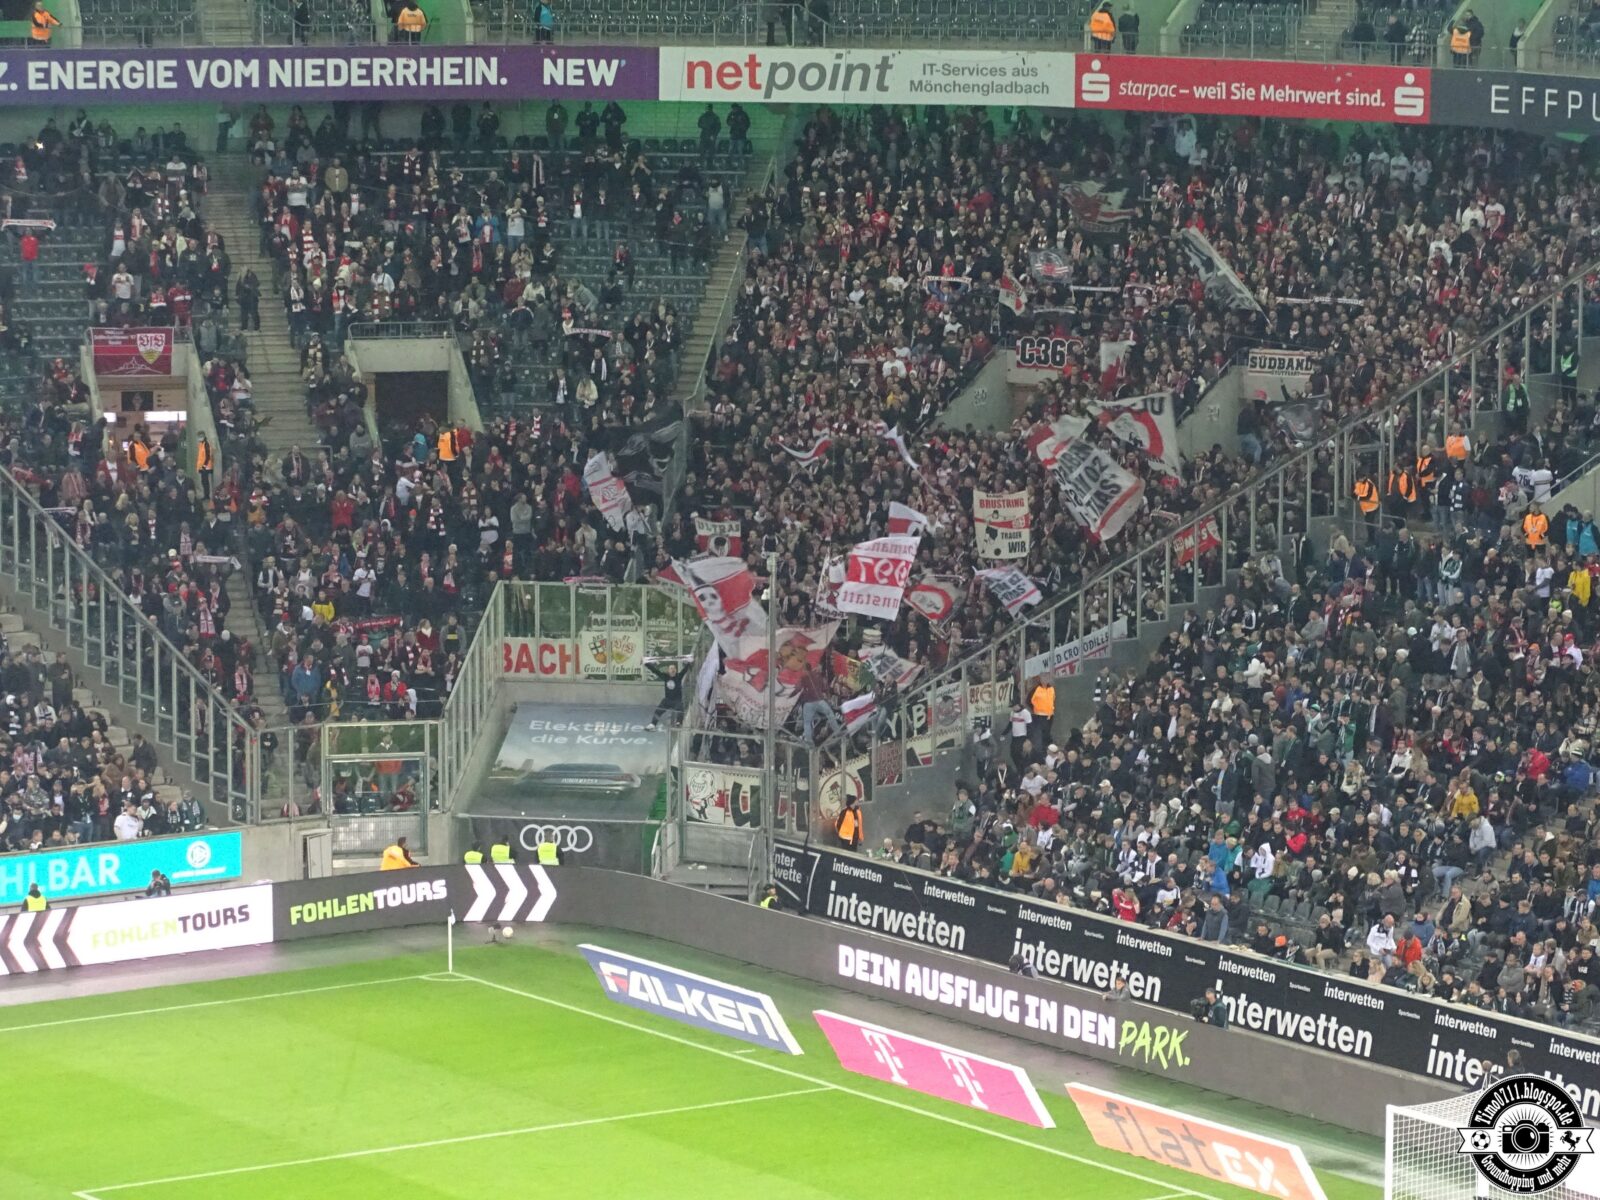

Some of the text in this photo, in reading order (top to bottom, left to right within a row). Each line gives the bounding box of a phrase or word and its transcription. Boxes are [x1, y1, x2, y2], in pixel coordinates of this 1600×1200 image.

[27, 59, 178, 91] ENERGIE
[186, 58, 260, 89] VOM
[269, 56, 508, 89] NIEDERRHEIN.
[686, 53, 893, 99] netpoint
[909, 79, 1050, 96] Mönchengladbach
[921, 63, 1038, 78] IT-Services aus
[1118, 81, 1177, 100] starpac
[1193, 82, 1227, 101] weil
[1230, 82, 1256, 101] Sie
[1260, 84, 1342, 106] Mehrwert
[1345, 87, 1387, 108] sind.
[1249, 355, 1313, 371] SÜDBAND
[1008, 541, 1027, 553] WIR
[531, 734, 653, 745] die Kurve.
[290, 879, 447, 925] FOHLENTOURS
[826, 880, 966, 951] interwetten
[1013, 928, 1162, 1003] interwetten
[832, 858, 882, 883] interwetten
[924, 881, 976, 907] interwetten
[1018, 904, 1072, 931] interwetten
[1116, 930, 1173, 957] interwetten
[1218, 955, 1276, 983] interwetten
[1324, 981, 1385, 1011] interwetten
[1434, 1008, 1497, 1039] interwetten
[598, 961, 780, 1043] FALKEN
[838, 944, 1191, 1070] DEIN AUSFLUG IN DEN PARK.
